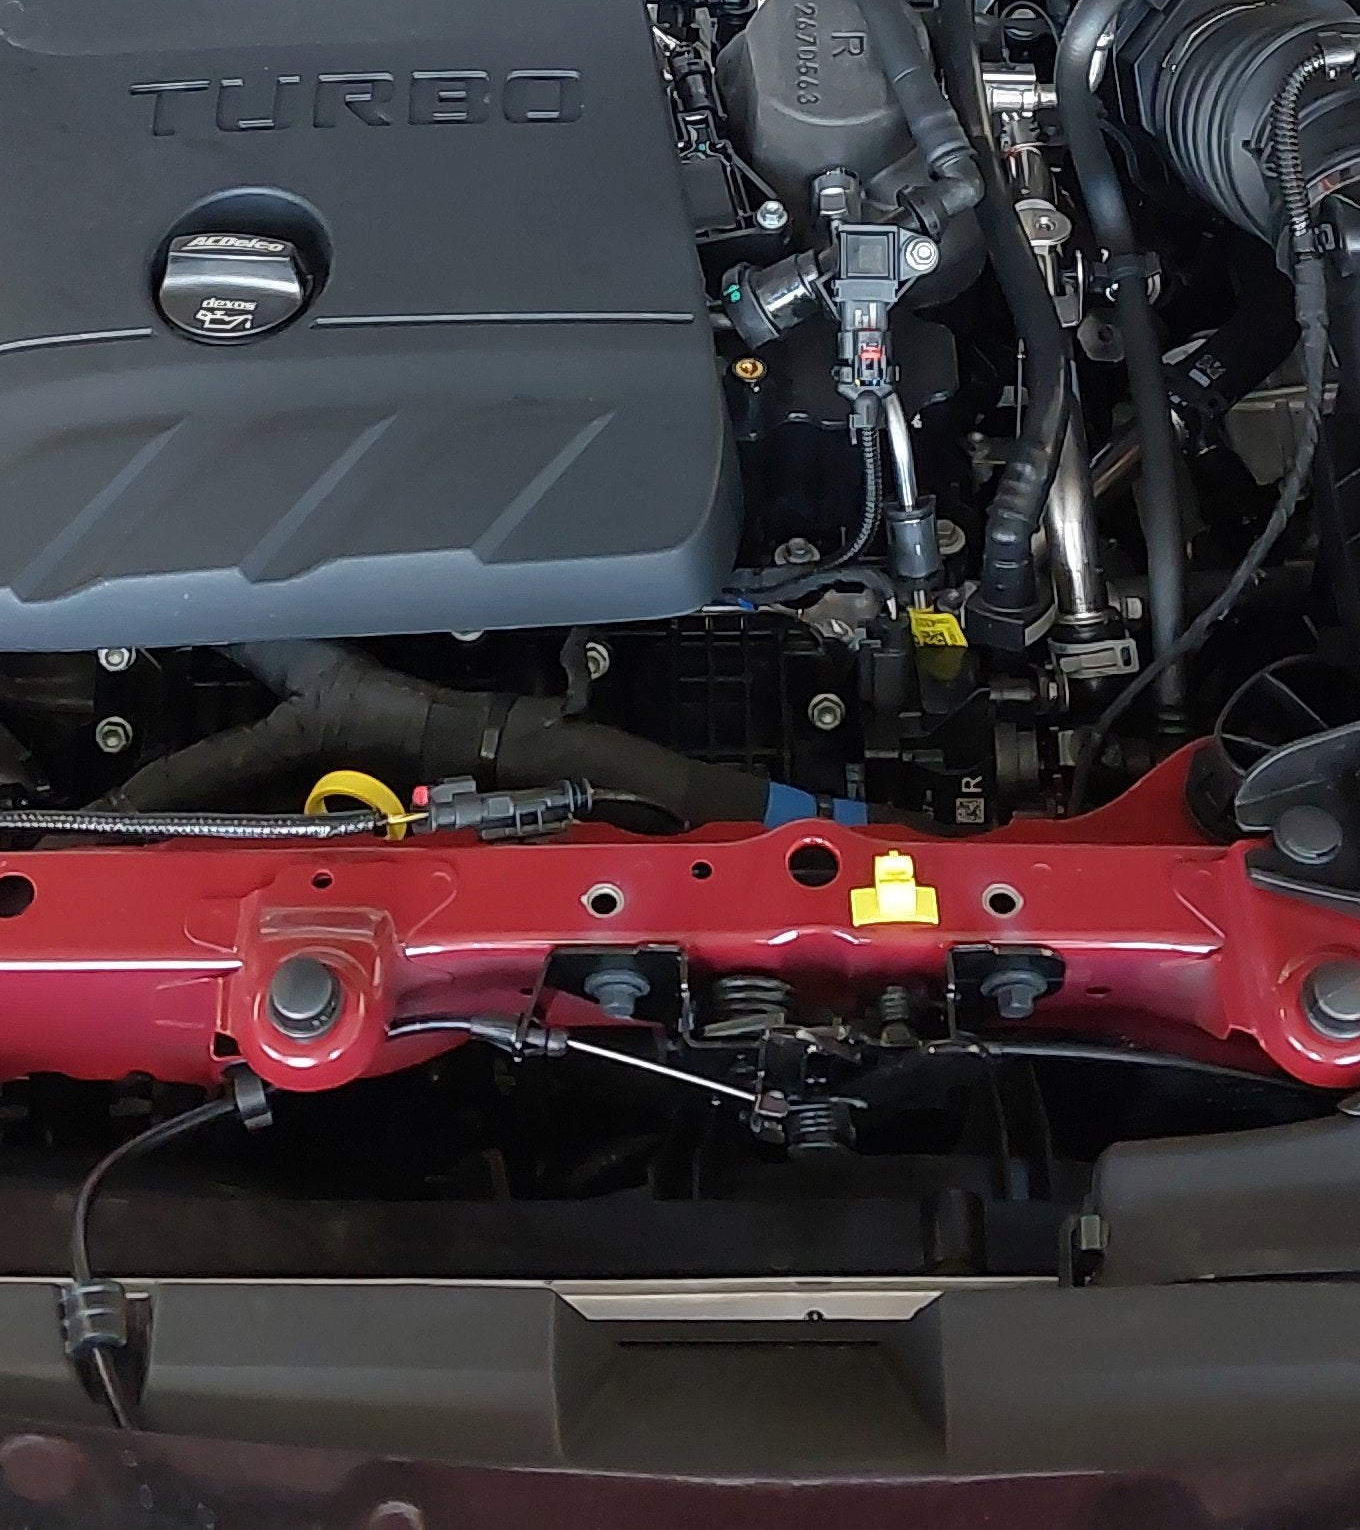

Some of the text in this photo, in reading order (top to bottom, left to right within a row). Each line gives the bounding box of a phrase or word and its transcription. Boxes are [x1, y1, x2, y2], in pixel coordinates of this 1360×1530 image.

[831, 31, 868, 58] R
[129, 69, 583, 136] TURBO
[186, 235, 285, 252] ACDelco
[202, 297, 257, 311] dexos
[961, 774, 983, 793] R
